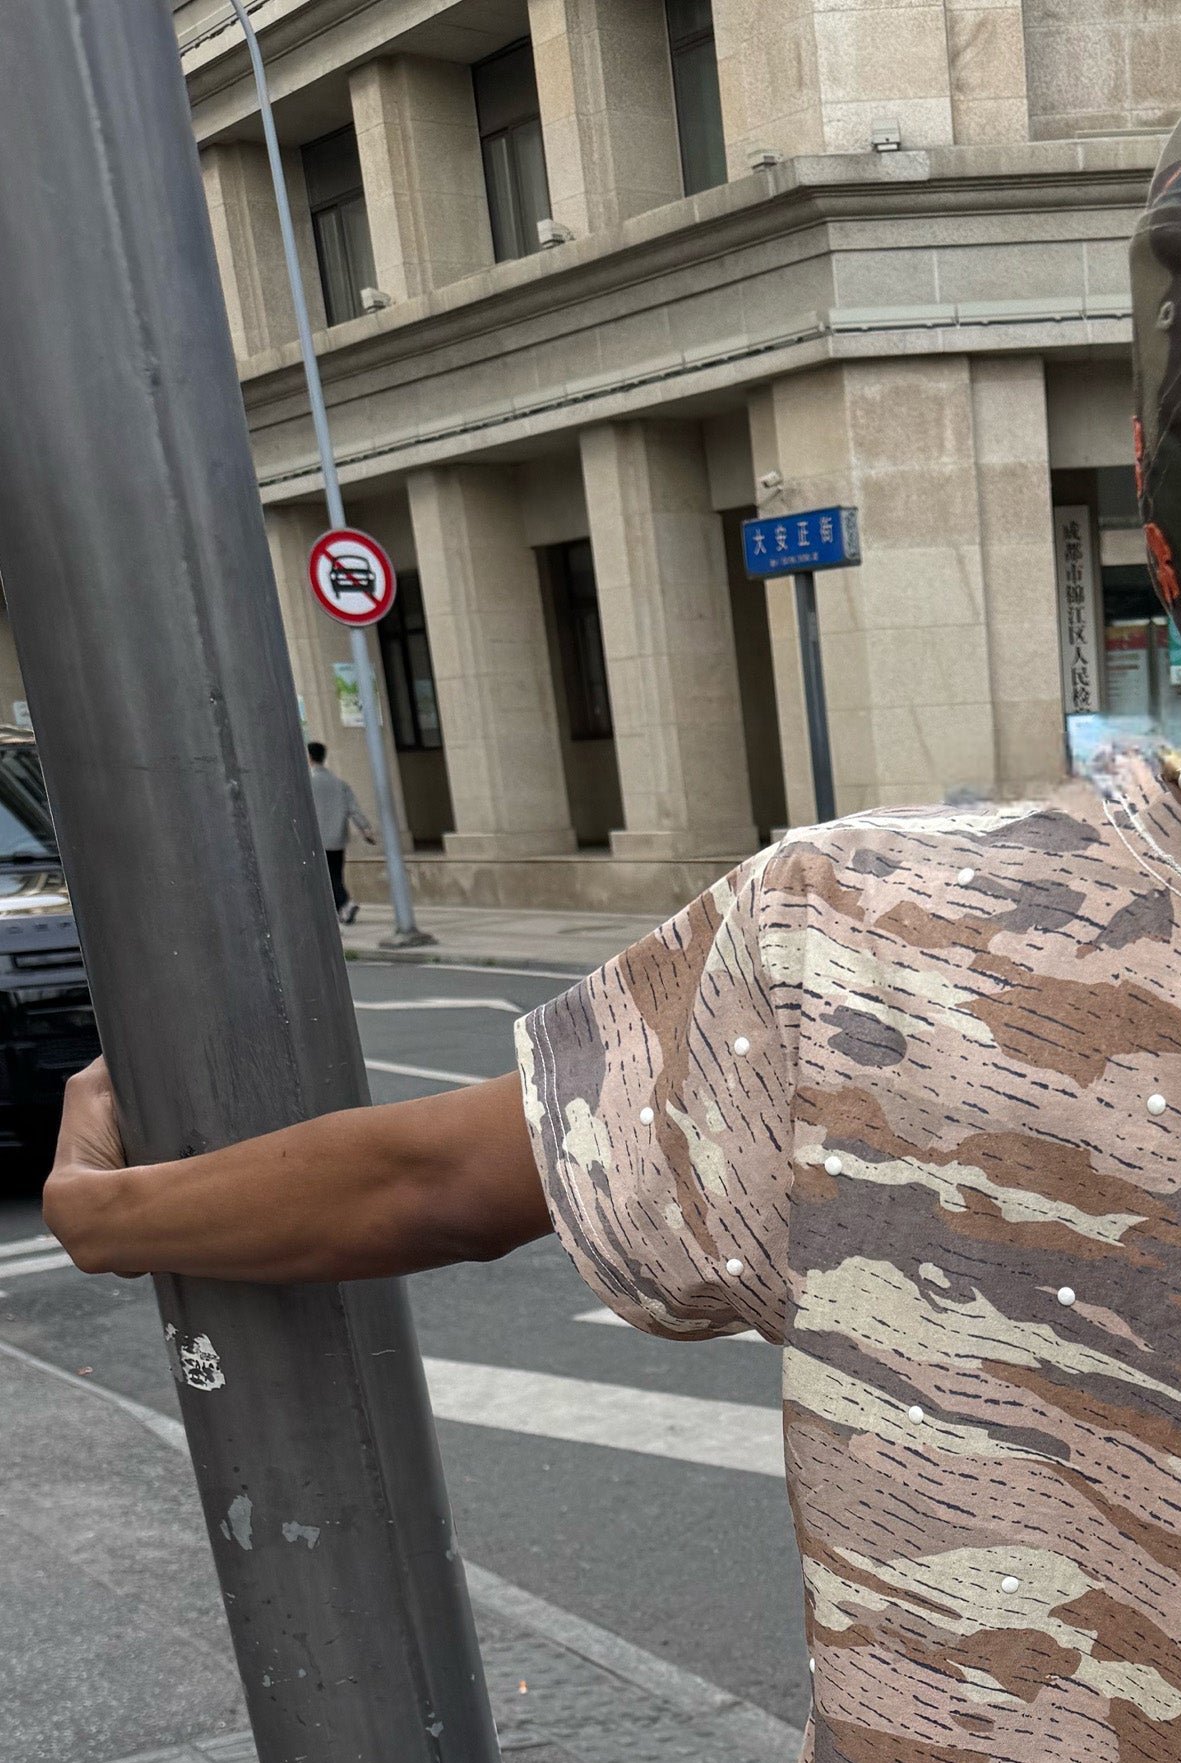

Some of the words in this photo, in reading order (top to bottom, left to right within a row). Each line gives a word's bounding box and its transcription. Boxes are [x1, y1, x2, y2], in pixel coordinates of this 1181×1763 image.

[752, 516, 834, 555] 大安正街
[1063, 520, 1091, 713] 成都市锦江区人民检
